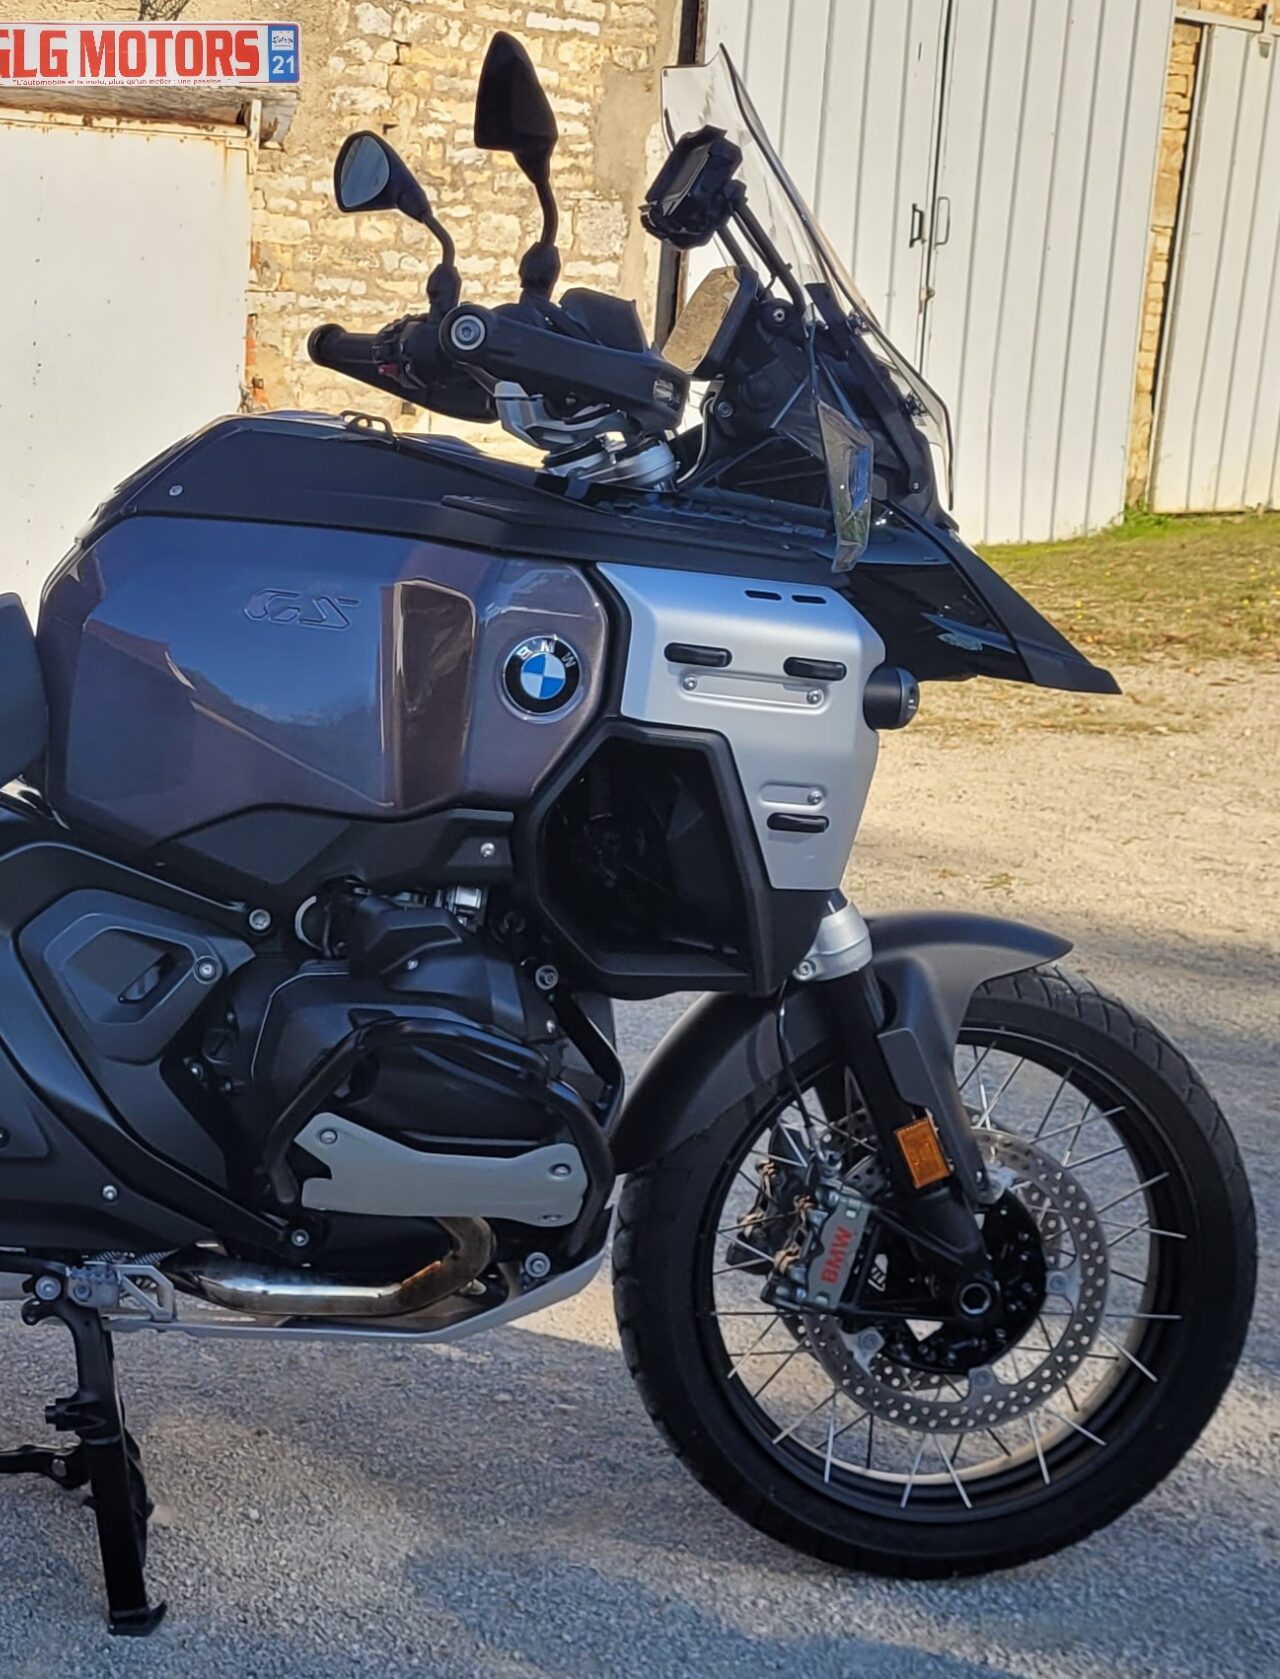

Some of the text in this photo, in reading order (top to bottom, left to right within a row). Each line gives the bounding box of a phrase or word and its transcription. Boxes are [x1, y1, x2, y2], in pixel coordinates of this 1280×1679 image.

[80, 29, 260, 78] MOTORS
[272, 55, 295, 74] 21
[244, 588, 360, 630] GS
[516, 639, 577, 669] BMW
[821, 1225, 852, 1284] BMW
